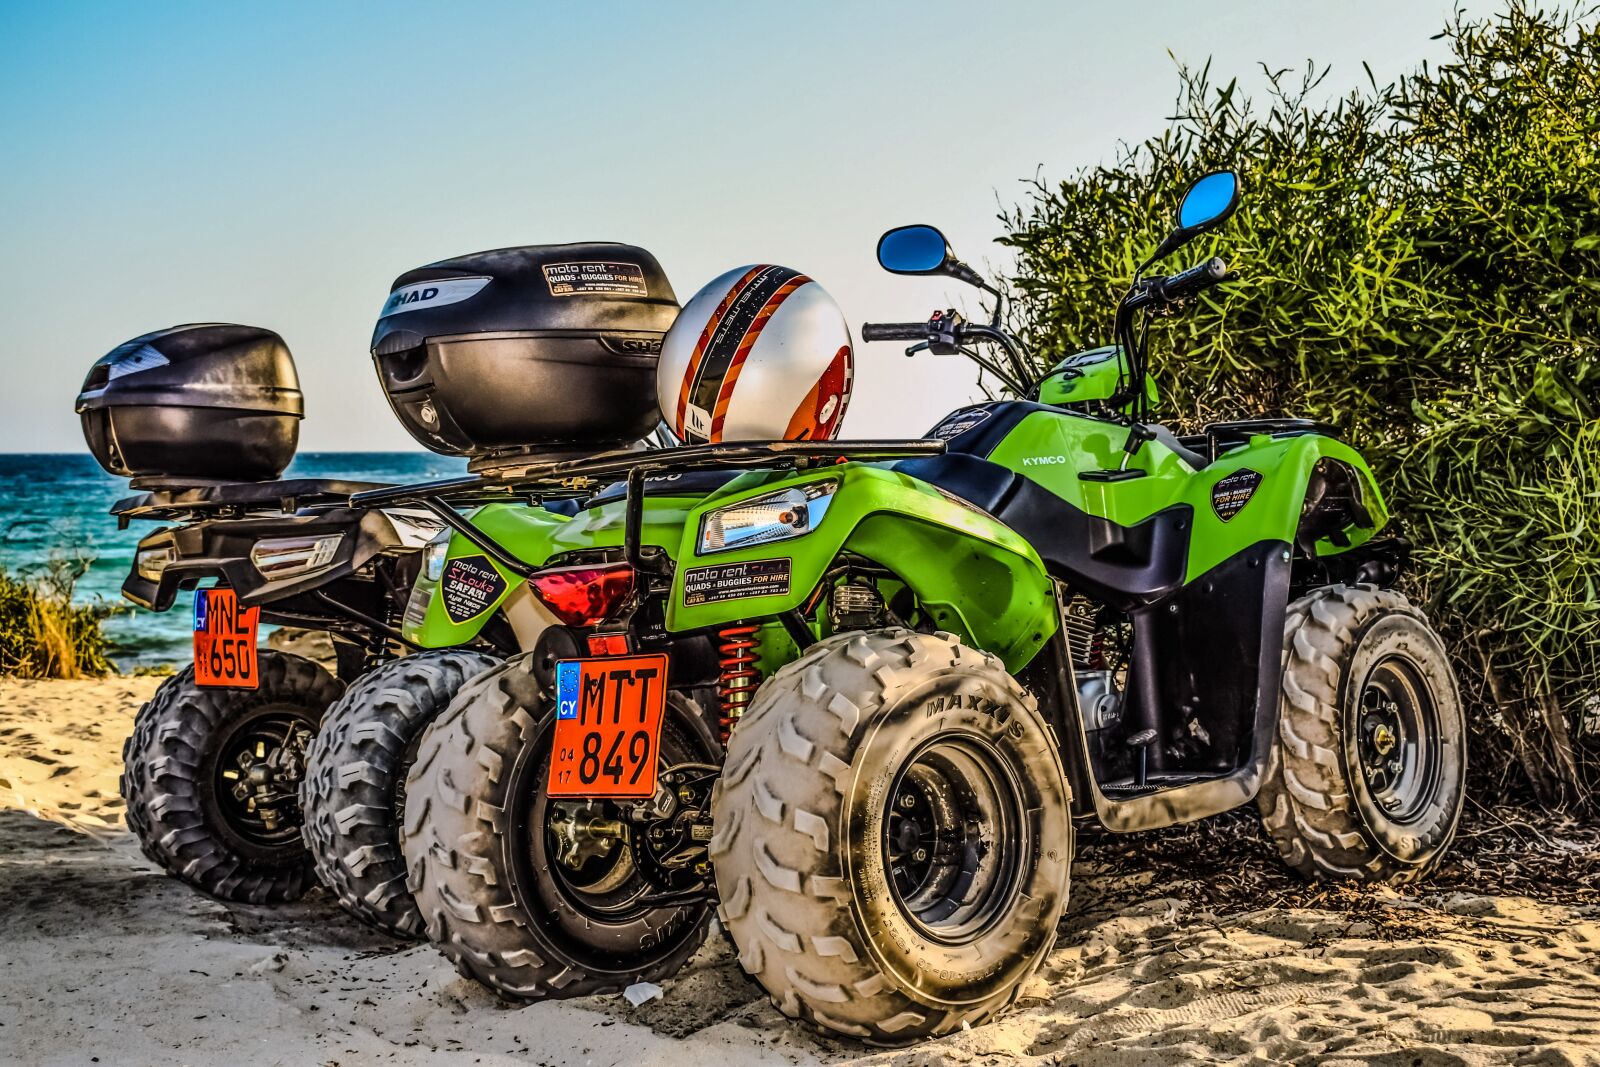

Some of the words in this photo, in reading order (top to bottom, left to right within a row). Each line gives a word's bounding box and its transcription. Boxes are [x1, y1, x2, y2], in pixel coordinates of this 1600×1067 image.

[546, 263, 579, 275] moto
[582, 263, 607, 273] rent
[549, 274, 576, 283] QUADS
[580, 273, 614, 281] BUGGIES
[1022, 455, 1066, 466] KYMCO
[1215, 496, 1231, 504] FOR
[1231, 493, 1251, 501] HIRE
[453, 560, 478, 575] moto
[478, 570, 499, 582] rent
[686, 568, 718, 583] moto
[721, 564, 748, 578] rent
[449, 580, 487, 600] SAFARI
[685, 582, 712, 593] QUADS
[717, 577, 752, 588] BUGGIES
[753, 575, 769, 584] FOR
[769, 573, 789, 582] HIRE
[210, 639, 251, 679] 650
[580, 668, 658, 726] MTT
[560, 700, 577, 715] CY
[560, 747, 574, 762] 04
[579, 730, 650, 785] 849
[558, 770, 571, 785] 17
